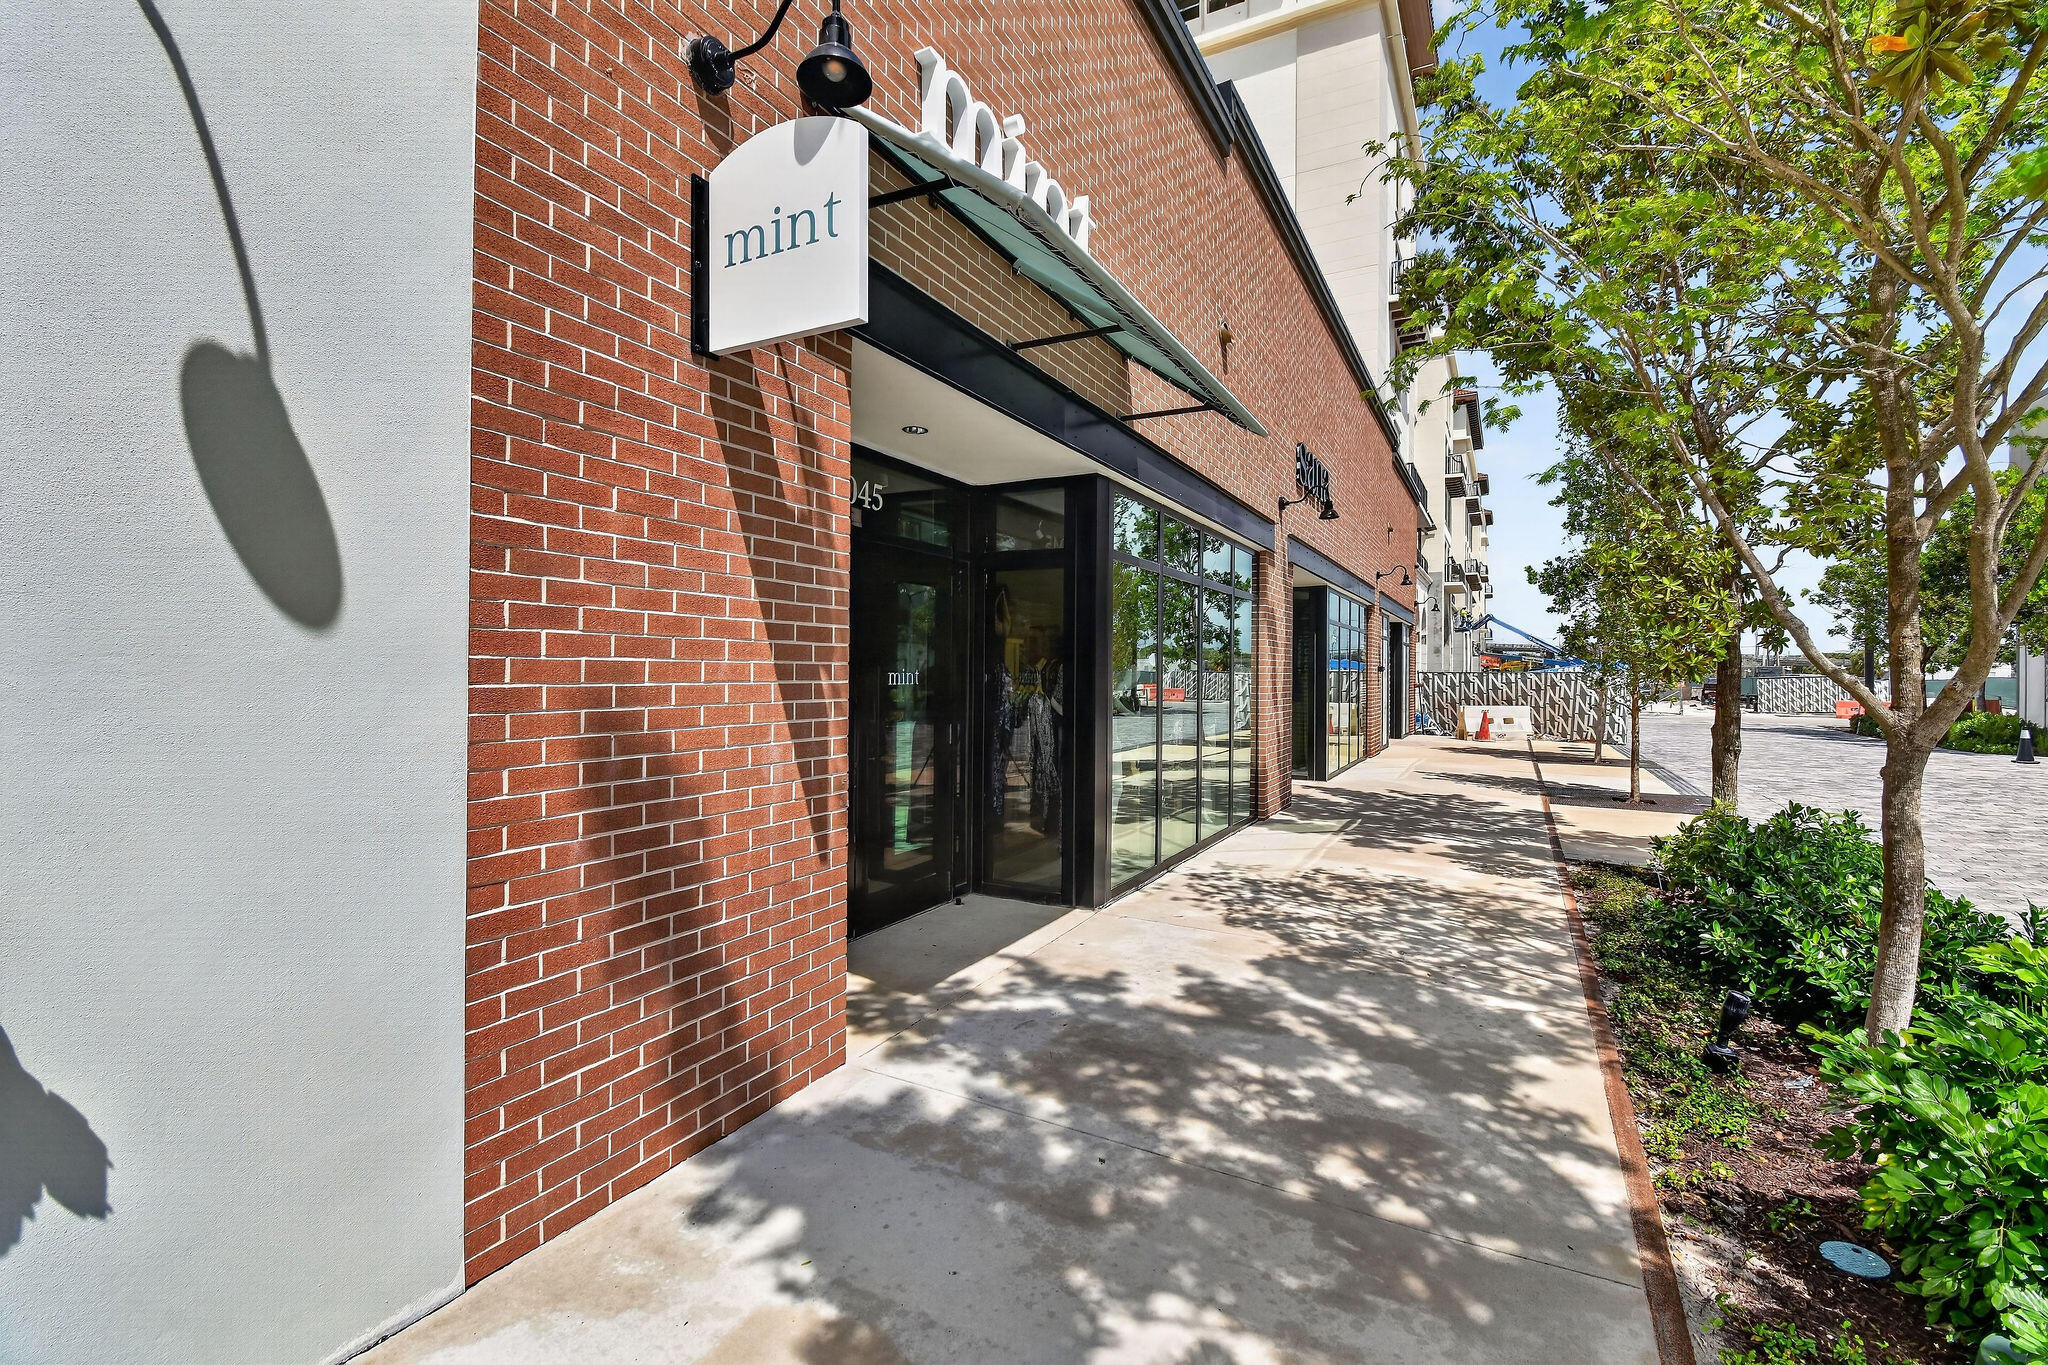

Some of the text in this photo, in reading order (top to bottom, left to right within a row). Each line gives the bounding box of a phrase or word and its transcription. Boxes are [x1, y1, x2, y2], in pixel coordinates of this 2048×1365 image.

[914, 46, 1098, 255] mint
[724, 191, 842, 268] mint
[887, 668, 920, 686] mint
